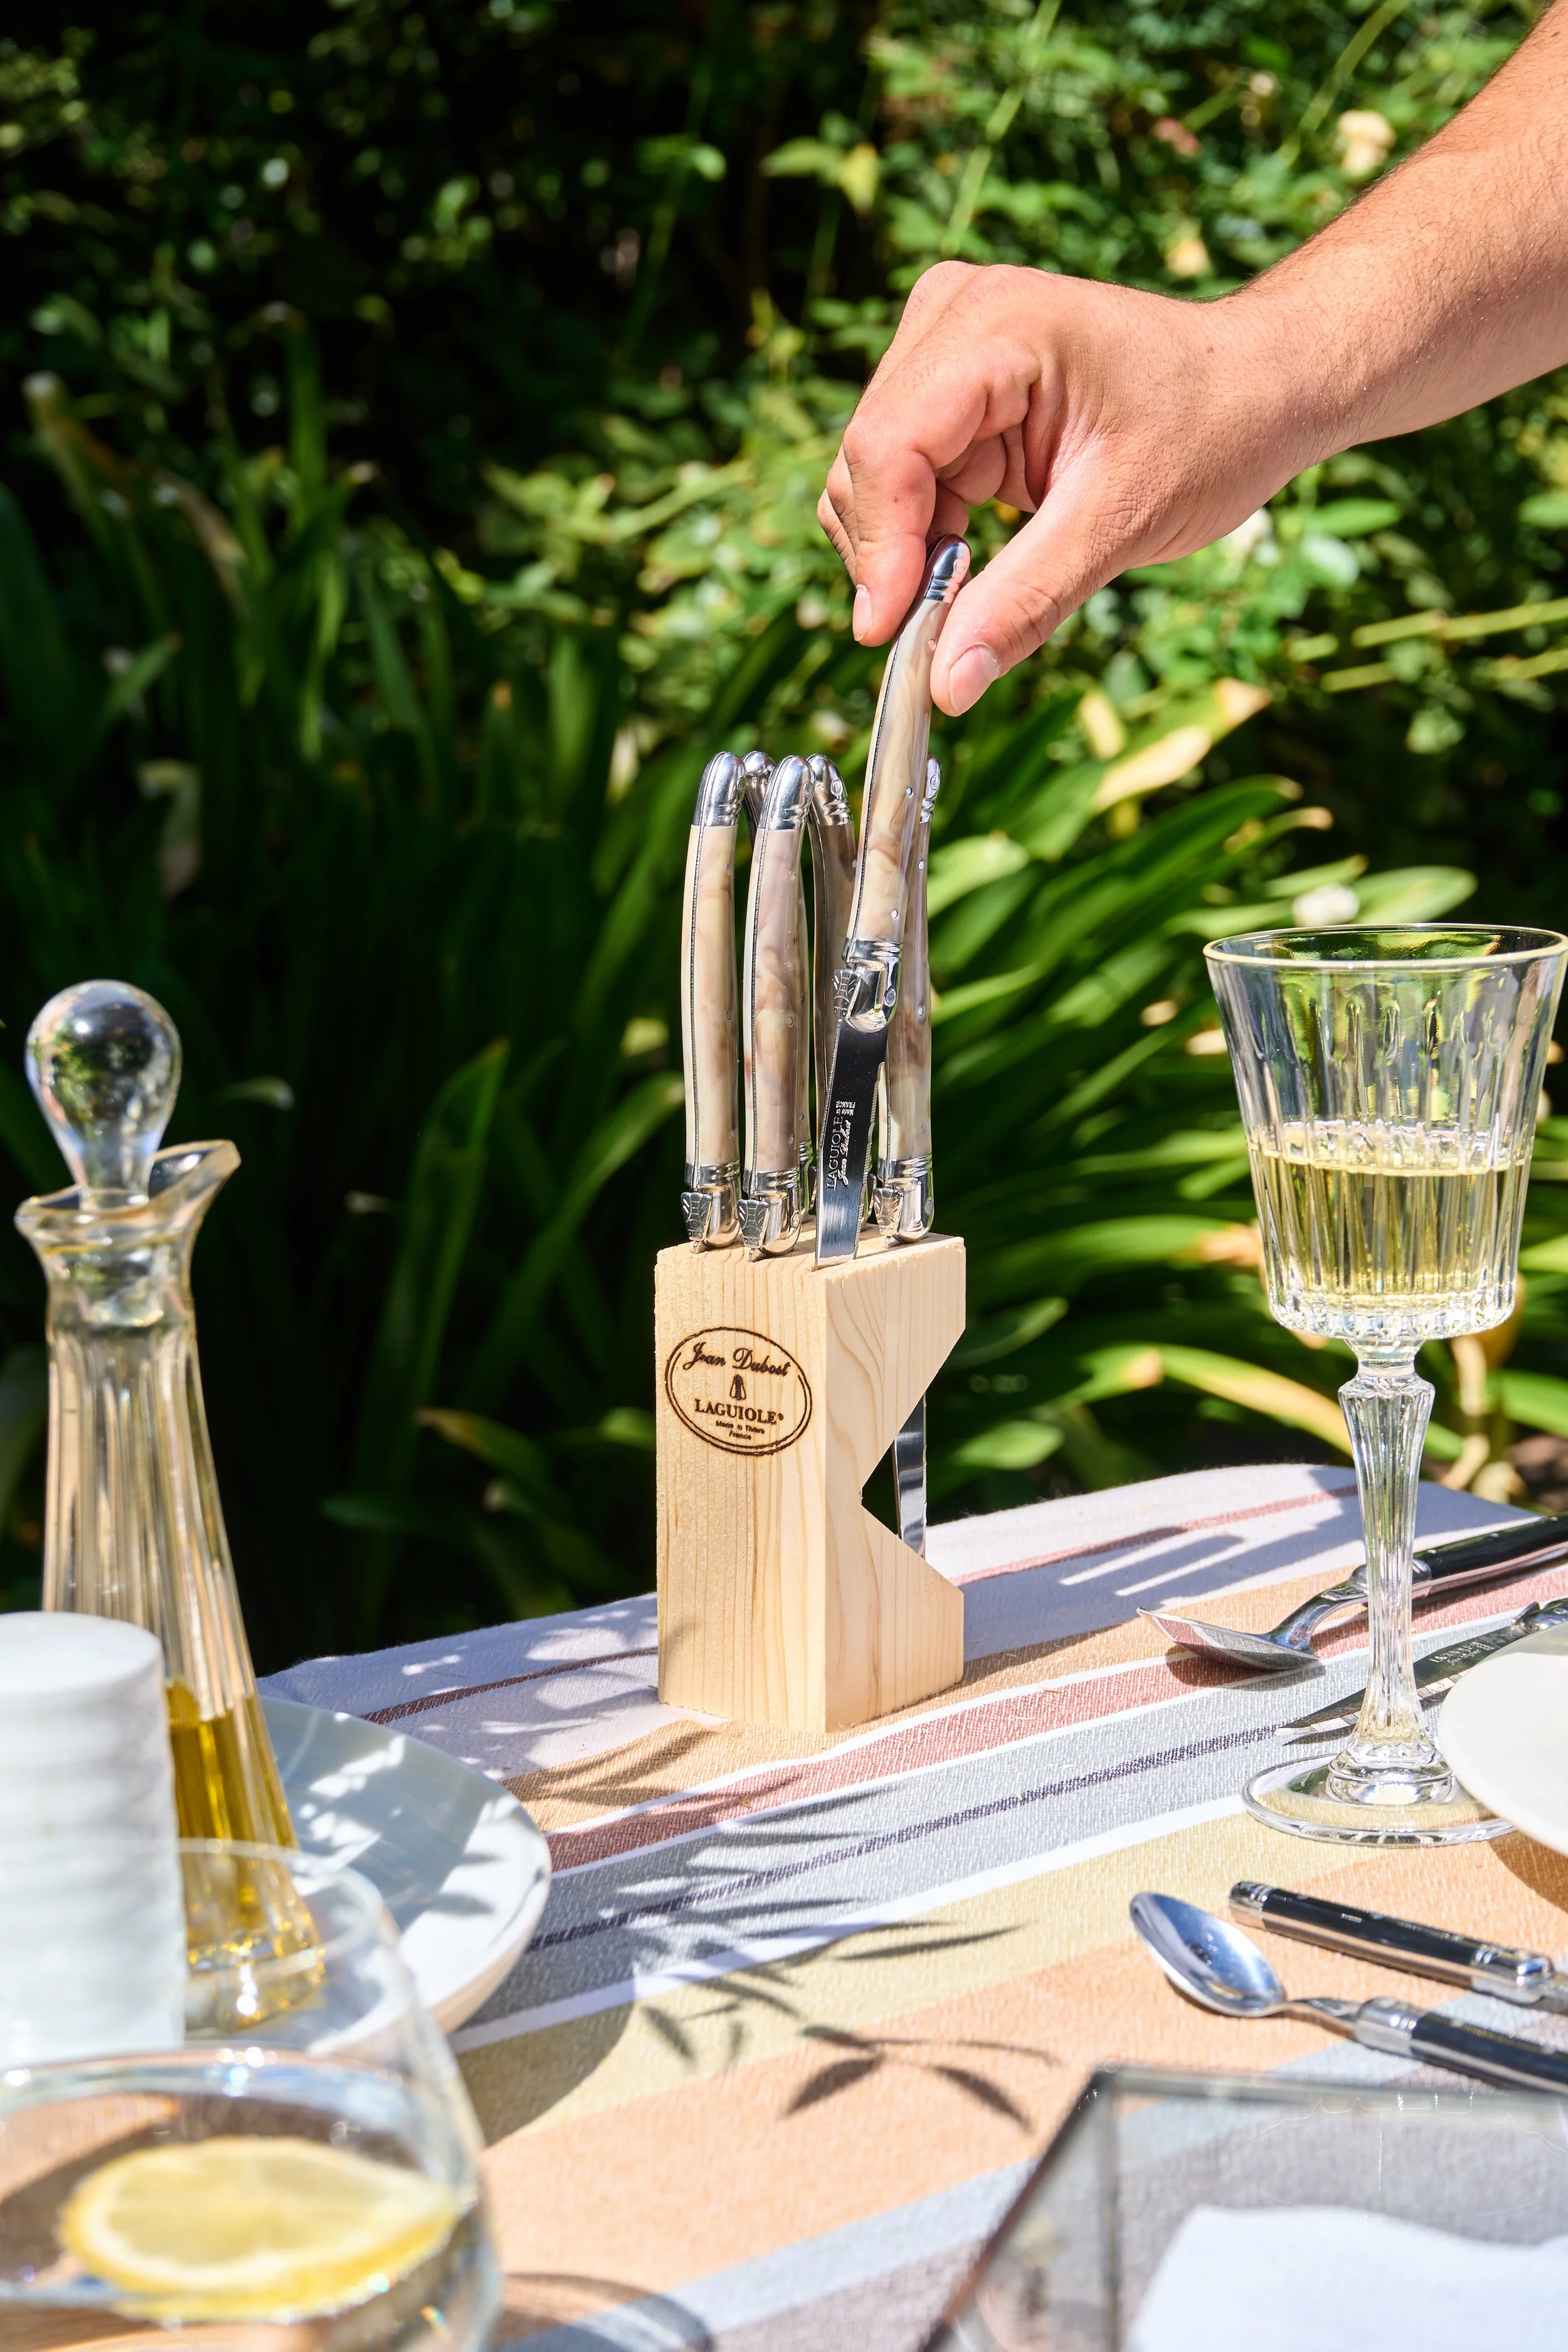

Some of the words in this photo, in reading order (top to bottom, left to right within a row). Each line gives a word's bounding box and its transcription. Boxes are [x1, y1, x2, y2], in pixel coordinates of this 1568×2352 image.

[835, 1100, 856, 1108] FRANCE
[826, 1116, 843, 1190] LAGUIOLE
[840, 1120, 851, 1157] Dubost
[837, 1158, 849, 1185] Jean
[683, 1342, 726, 1370] Jean
[733, 1348, 791, 1376] Dubost
